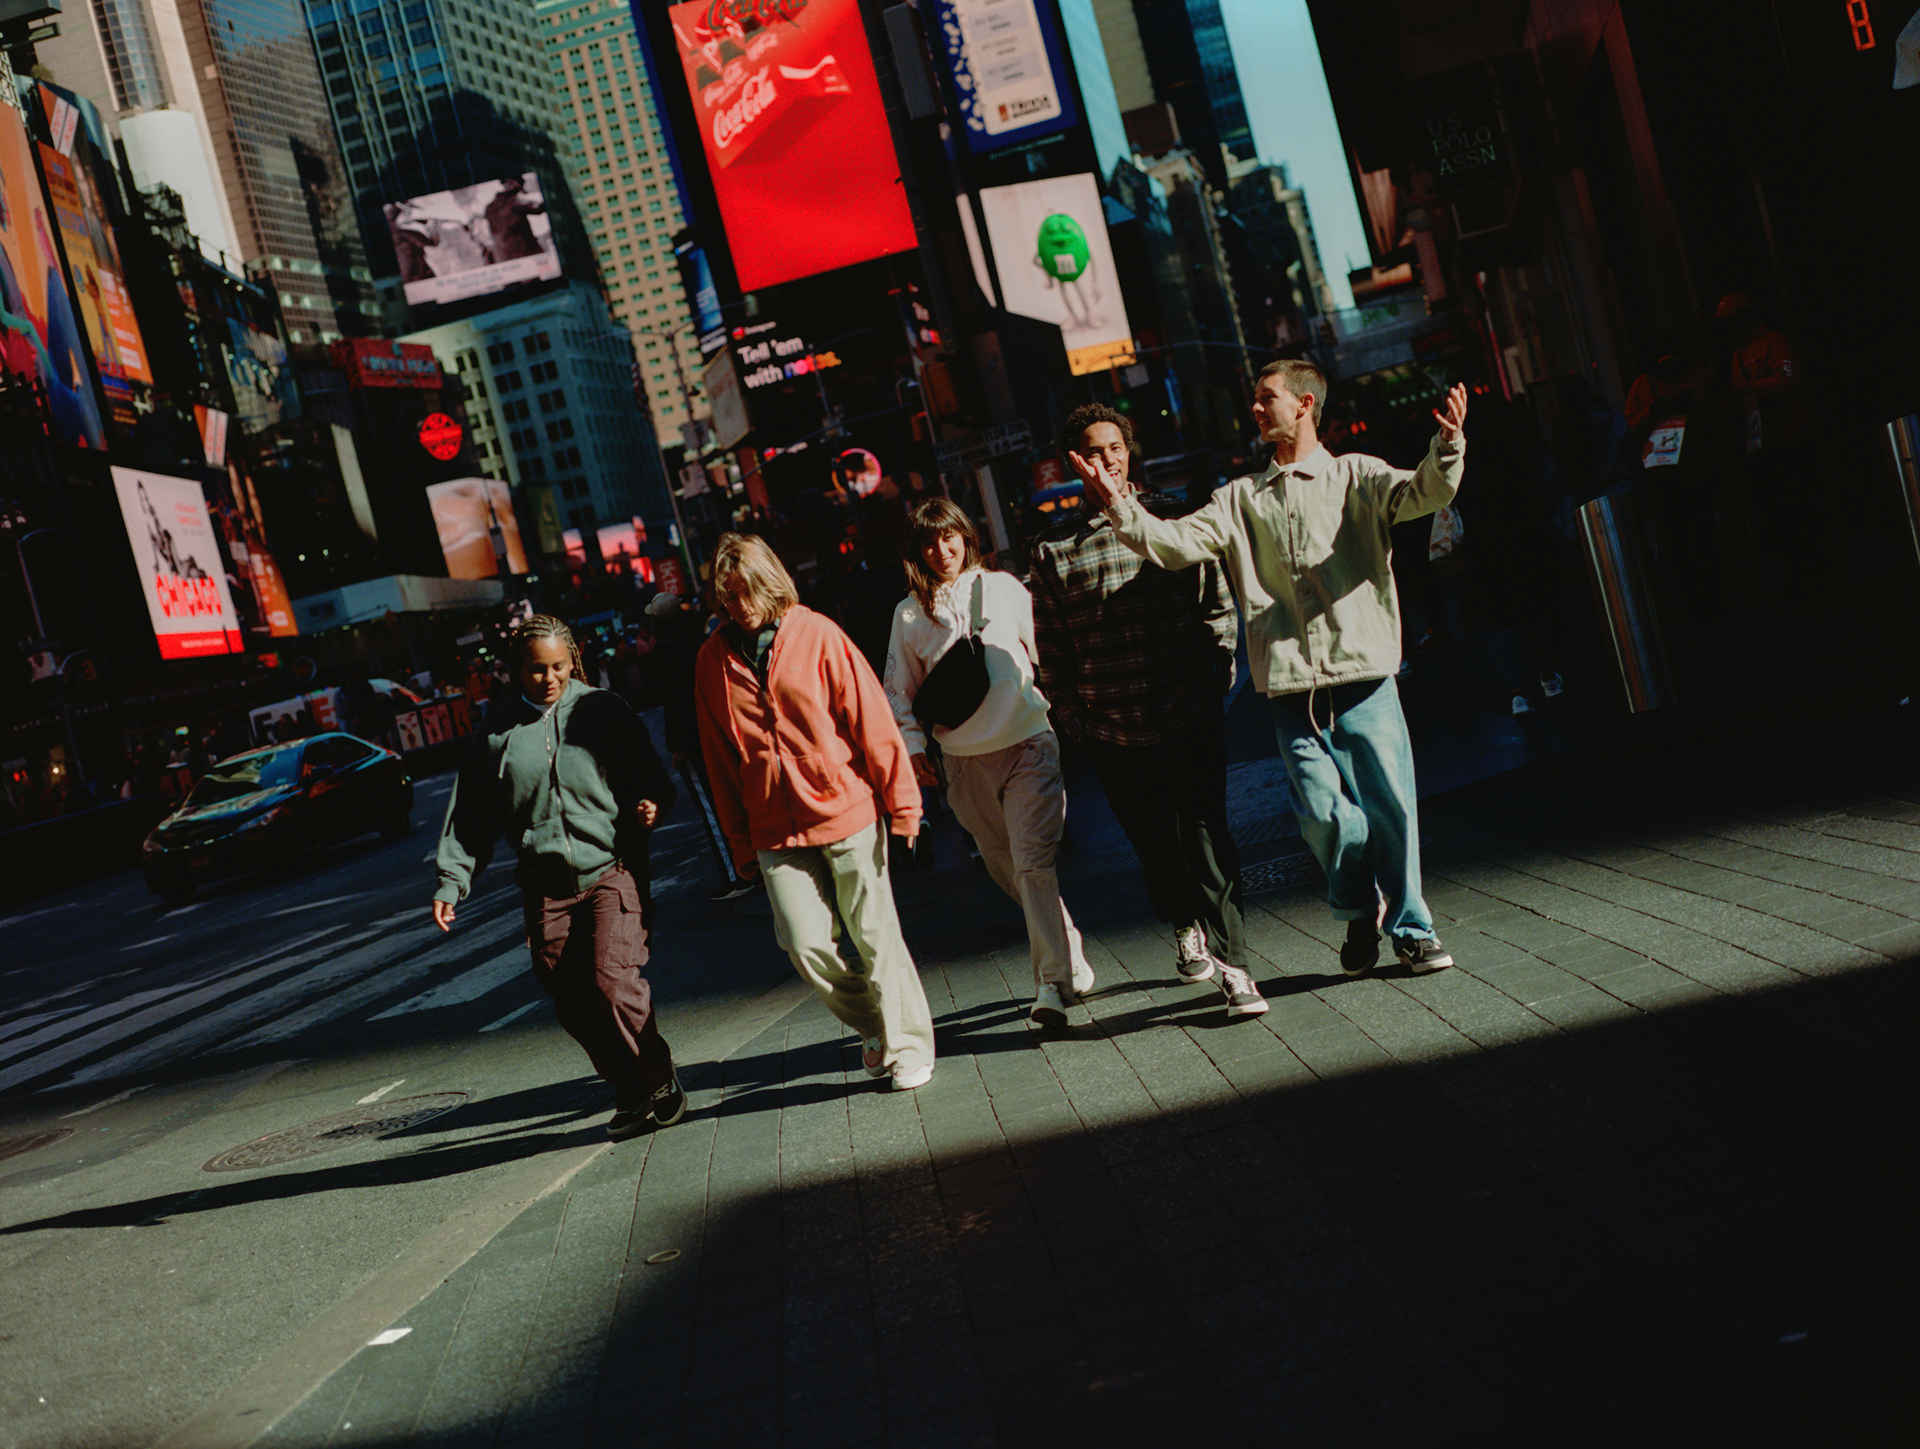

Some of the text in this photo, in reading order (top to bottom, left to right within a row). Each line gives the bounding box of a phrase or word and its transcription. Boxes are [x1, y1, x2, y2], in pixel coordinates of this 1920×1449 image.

[1845, 0, 1876, 51] 8
[1427, 114, 1468, 137] U.S.
[1432, 127, 1491, 157] POLO
[736, 342, 771, 365] Tell
[743, 364, 784, 389] with
[935, 420, 1030, 457] PEDESTRIAN FLOW ZONE
[939, 445, 993, 469] KEEP MOVING
[156, 572, 223, 618] CHICAGO
[13, 702, 110, 732] AMERICA EAGLE
